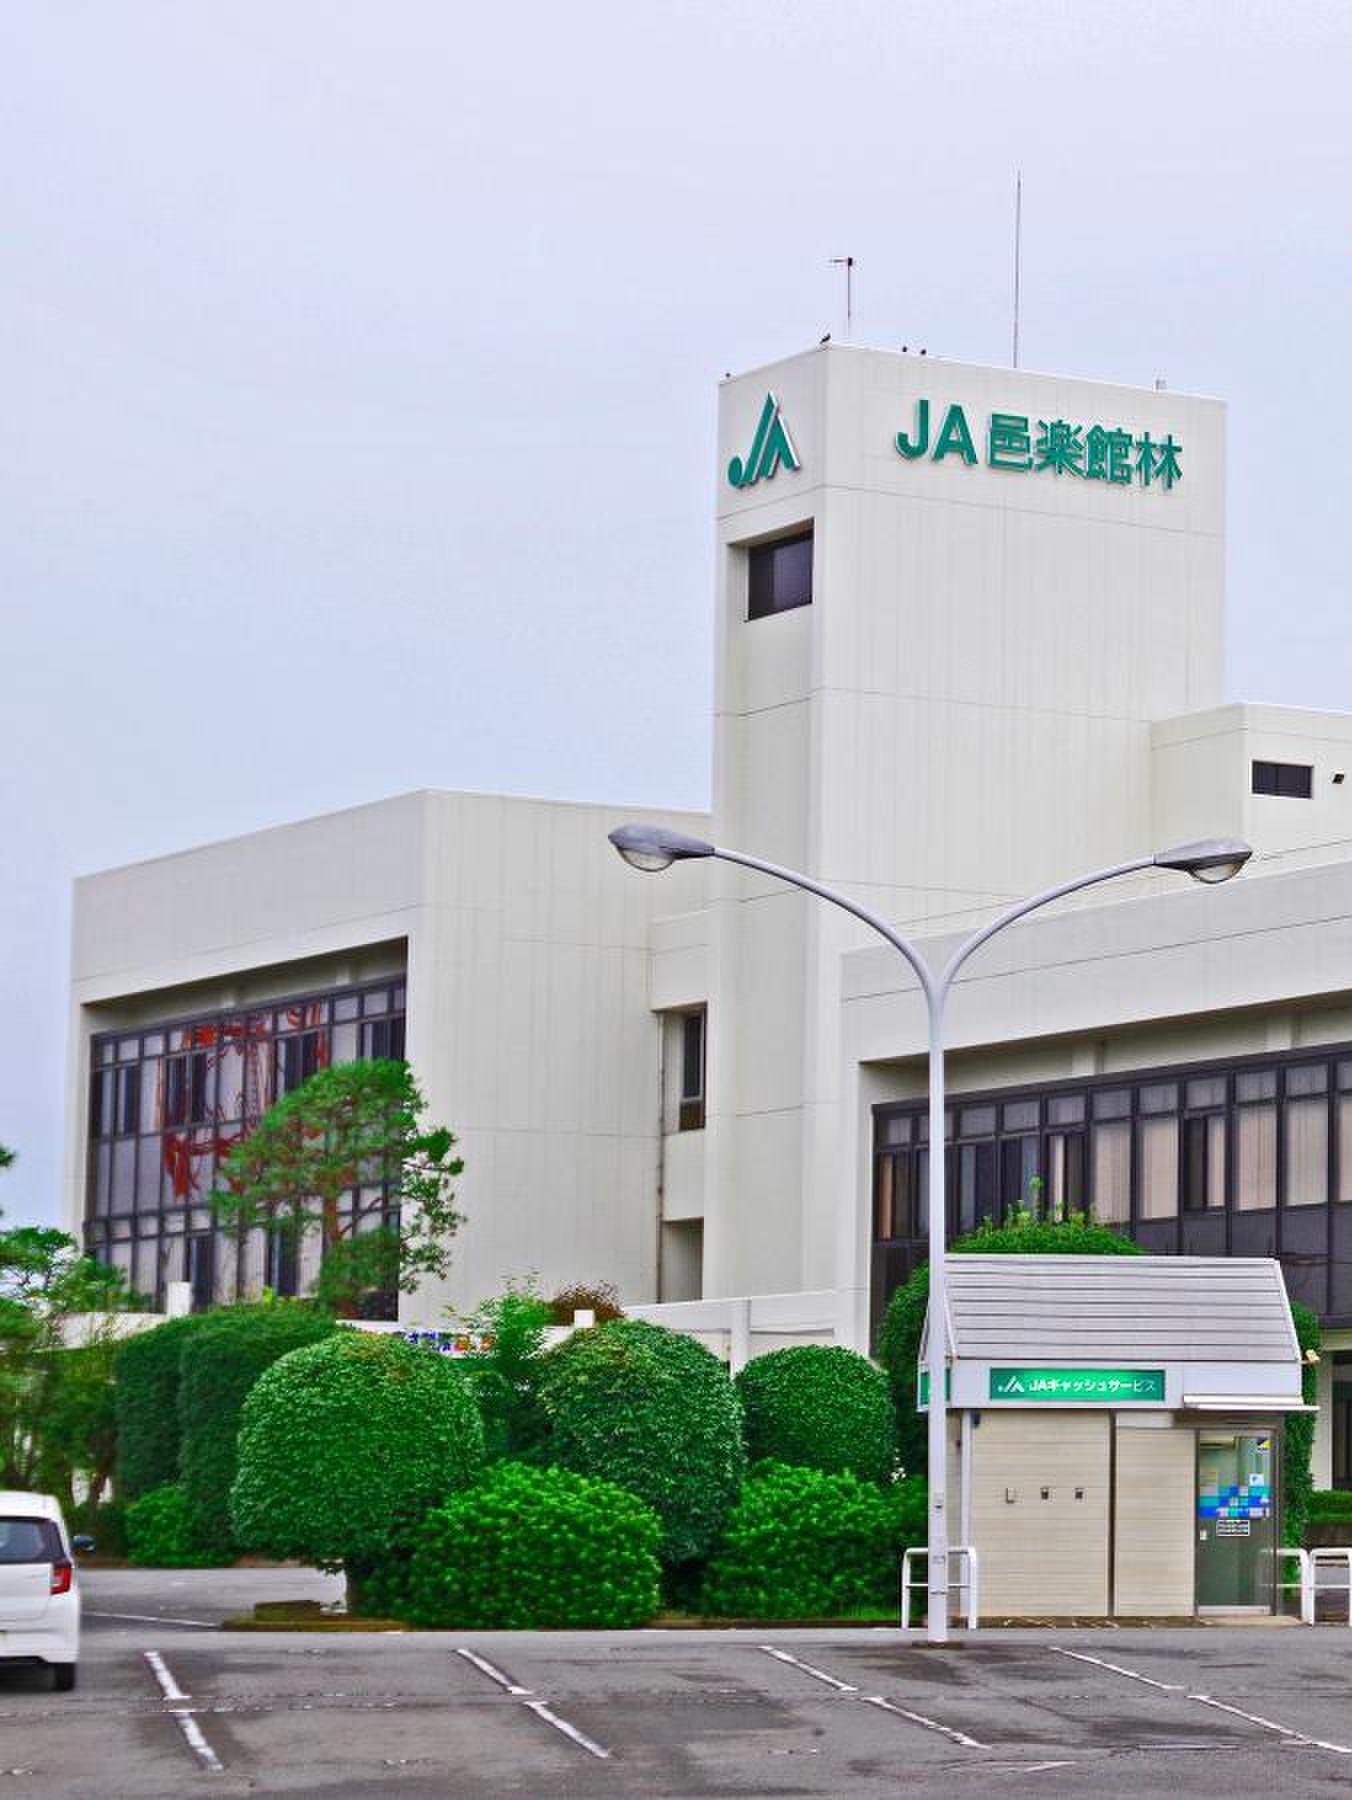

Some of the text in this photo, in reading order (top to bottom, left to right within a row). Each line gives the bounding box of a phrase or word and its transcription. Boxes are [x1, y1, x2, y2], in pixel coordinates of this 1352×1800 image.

[896, 399, 1183, 488] JA邑楽館林
[1029, 1378, 1156, 1392] JAキャッシュサービス
